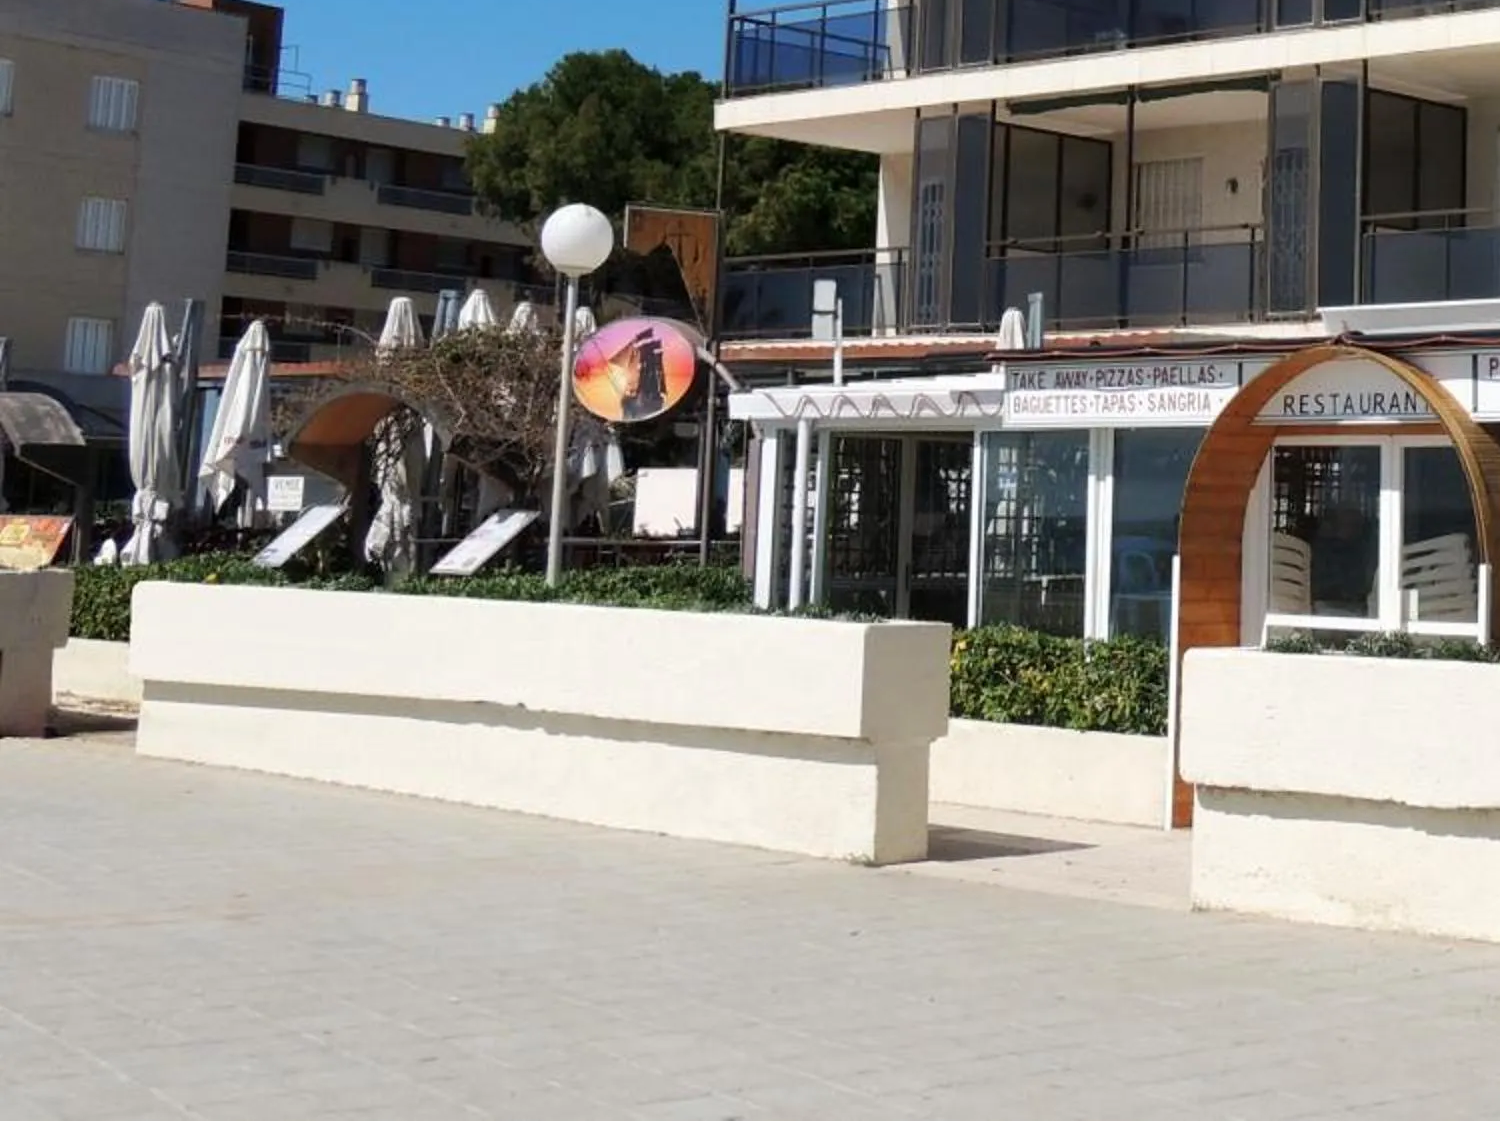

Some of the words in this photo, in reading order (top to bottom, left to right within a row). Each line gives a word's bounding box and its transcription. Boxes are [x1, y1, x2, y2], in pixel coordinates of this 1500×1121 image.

[1012, 371, 1047, 390] TAKE
[1055, 370, 1088, 390] AWAY
[1095, 367, 1144, 388] PIZZAS
[1153, 364, 1215, 385] PAELLAS
[1013, 394, 1087, 414] BAGUETTES
[1147, 391, 1211, 412] SANGRIA
